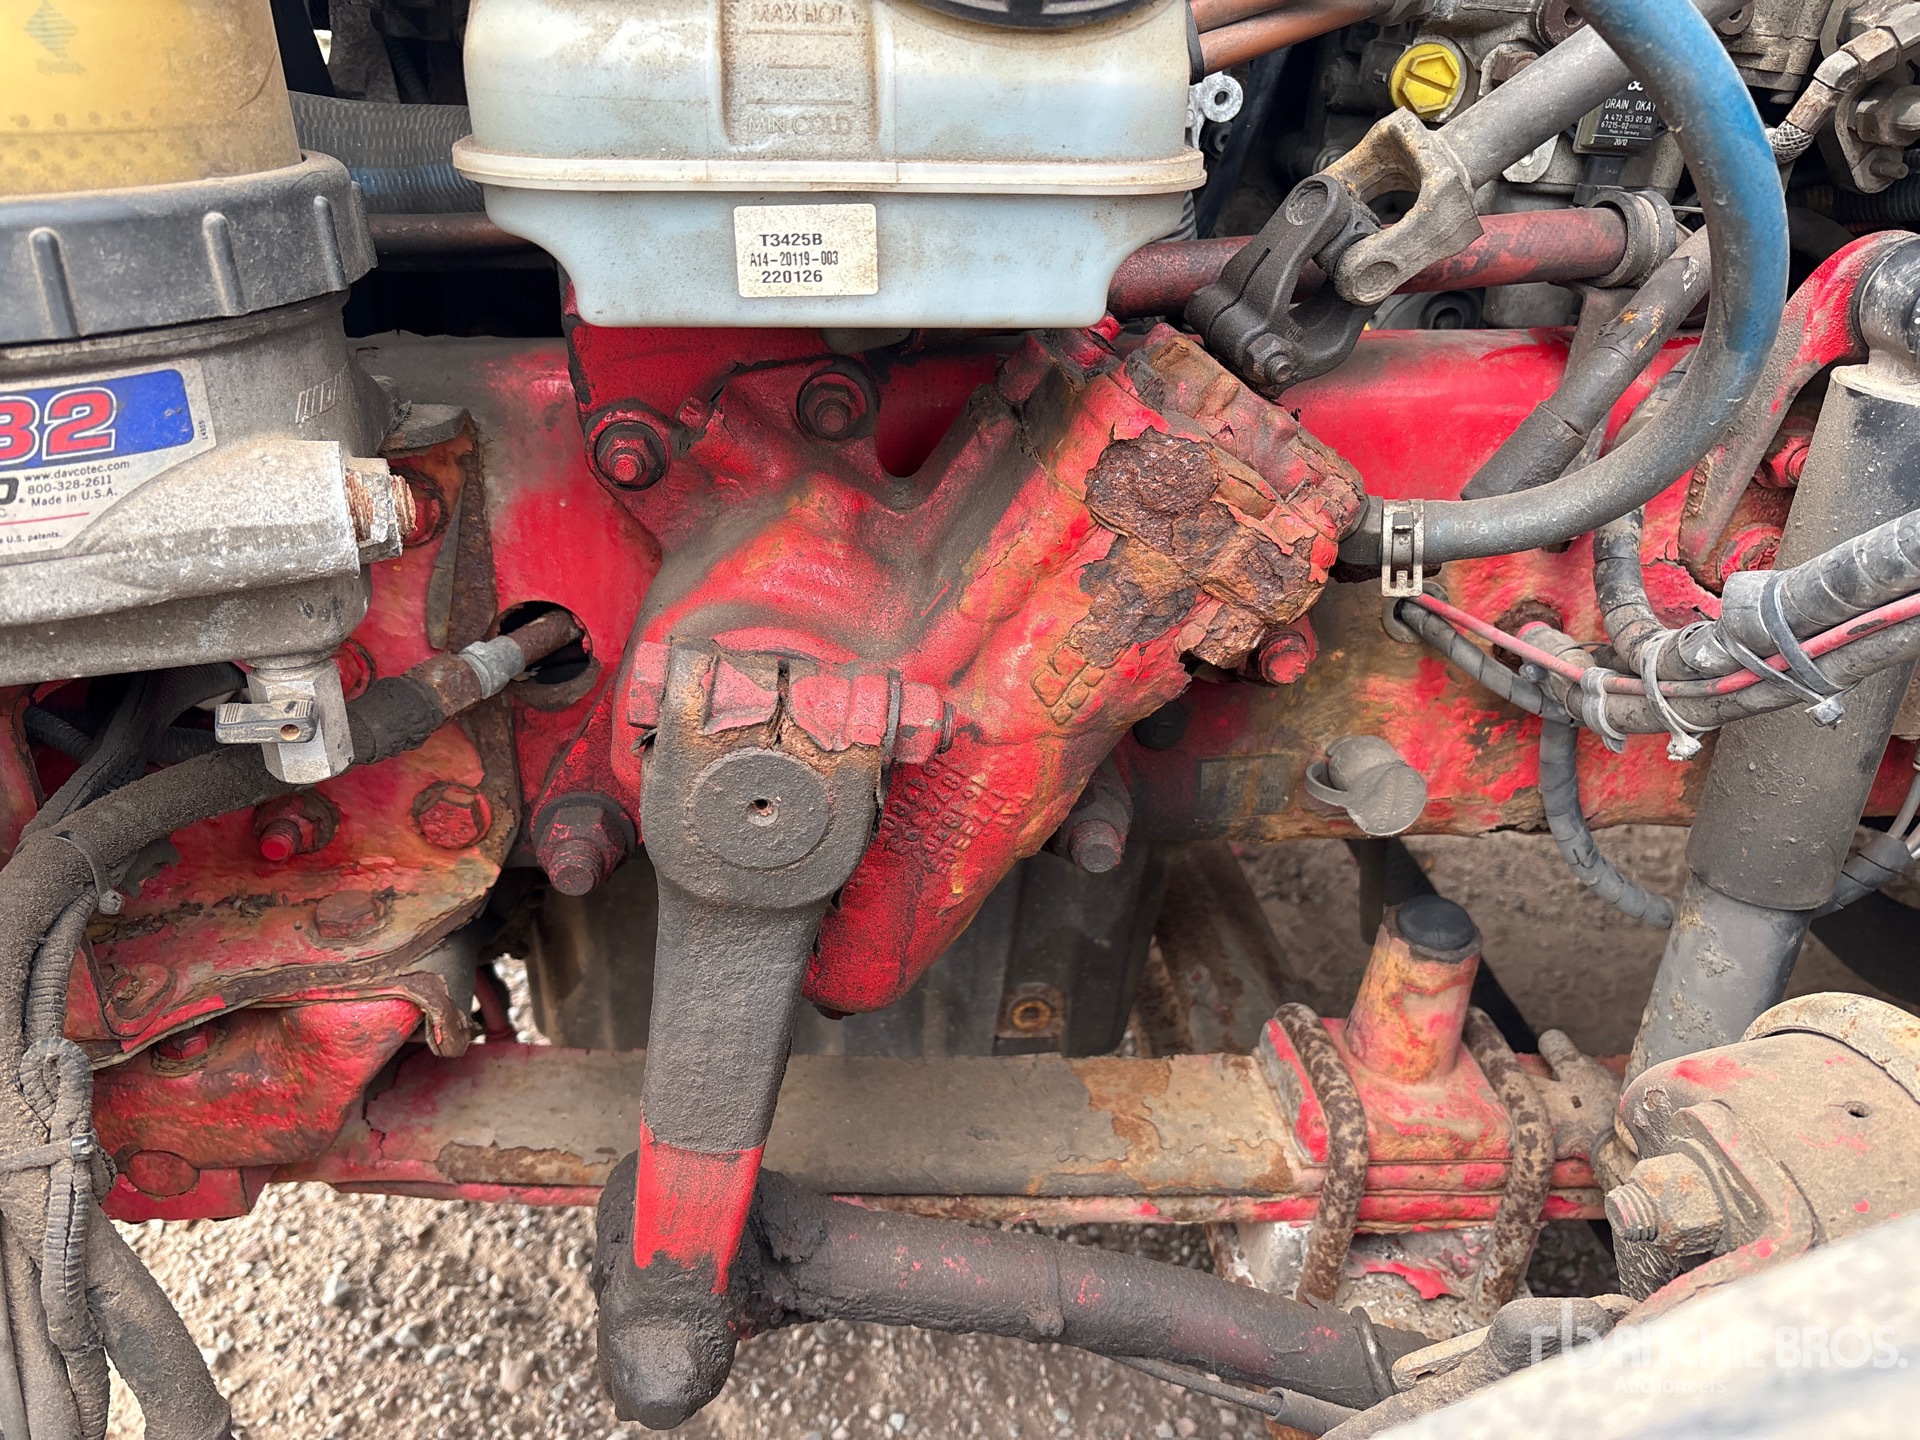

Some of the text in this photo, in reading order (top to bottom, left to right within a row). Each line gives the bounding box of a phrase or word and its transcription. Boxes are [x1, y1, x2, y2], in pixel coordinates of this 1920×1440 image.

[1604, 98, 1630, 110] DRAIN
[748, 113, 851, 135] MIN COLD
[1600, 120, 1630, 130] 67215-02
[1604, 113, 1653, 124] A 472 153 05 28
[759, 233, 823, 247] T3425B
[750, 250, 839, 268] A14-20119-003
[761, 270, 823, 284] 220126
[24, 461, 130, 482] www.davcotec.com
[27, 475, 113, 495] 800-328-2611
[31, 487, 119, 507] Made in U.S.A.
